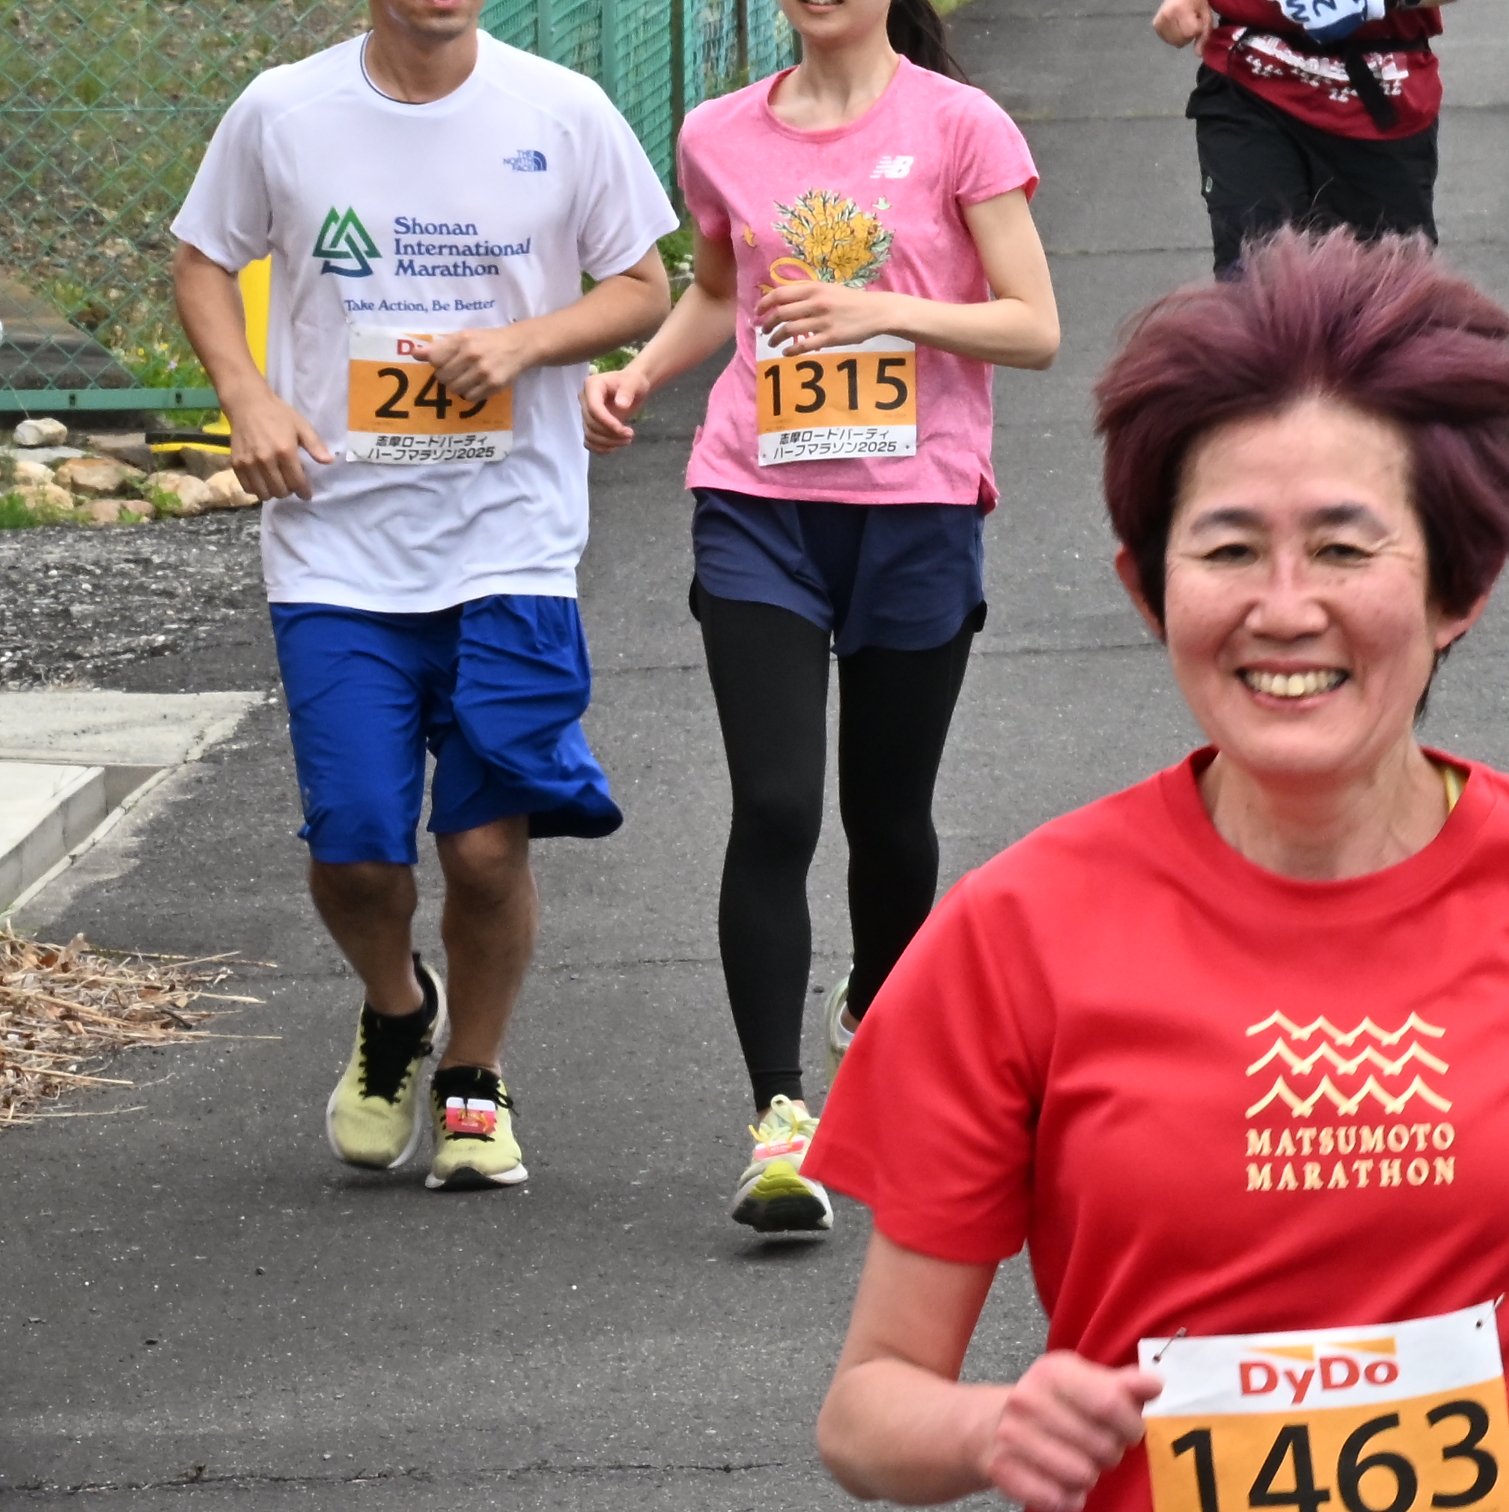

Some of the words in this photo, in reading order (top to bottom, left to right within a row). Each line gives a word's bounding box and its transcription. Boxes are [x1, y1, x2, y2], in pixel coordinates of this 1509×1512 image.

[503, 157, 534, 166] NORTH
[516, 149, 534, 158] THE
[394, 215, 478, 235] Shonan
[394, 236, 532, 257] International
[395, 259, 500, 276] Marathon
[345, 299, 375, 312] Take
[378, 299, 429, 313] Action,
[432, 299, 450, 312] Be
[454, 298, 496, 311] Better
[764, 358, 909, 416] 1315
[368, 446, 495, 461] ハーフマラソン2025
[773, 441, 897, 459] ハーフマラソン2025
[1245, 1122, 1456, 1157] MATSUMOTO
[1246, 1156, 1456, 1191] MARATHON
[1238, 1355, 1400, 1405] DyDo
[1170, 1399, 1499, 1512] 1463
